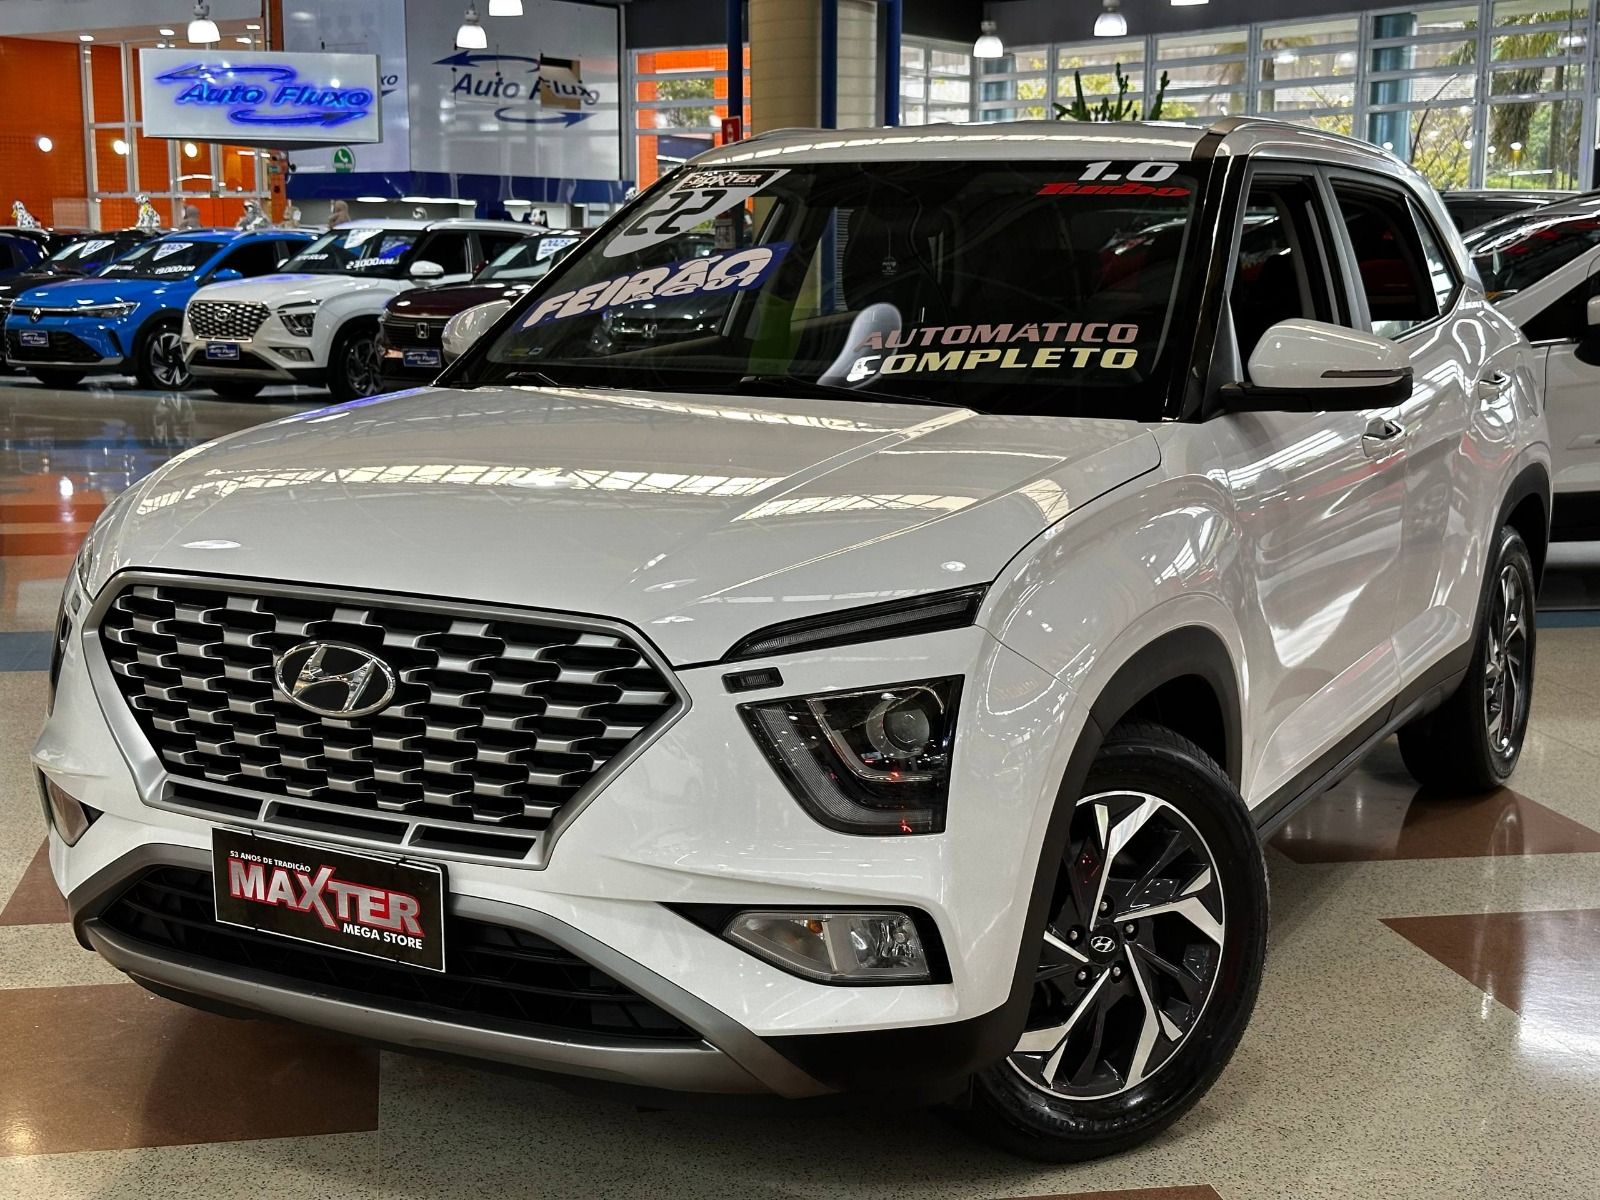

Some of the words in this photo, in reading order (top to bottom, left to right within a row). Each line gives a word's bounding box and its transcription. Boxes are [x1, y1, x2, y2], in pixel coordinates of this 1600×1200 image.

[176, 82, 265, 106] Auto
[272, 85, 373, 108] Fluxo
[453, 74, 520, 98] Auto
[1078, 161, 1179, 182] 1.0
[1036, 183, 1191, 197] Turbo
[624, 190, 728, 236] 22
[523, 248, 772, 327] FEIRÃO
[857, 323, 1138, 350] AUTOMÁTICO
[847, 348, 1138, 381] COMPLETO
[230, 850, 239, 858] 53
[240, 853, 262, 863] ANOS
[263, 857, 273, 866] DE
[274, 858, 311, 873] TRADIÇÃO
[228, 856, 425, 937] MAXTER
[343, 923, 380, 941] MEGA
[384, 932, 423, 950] STORE
